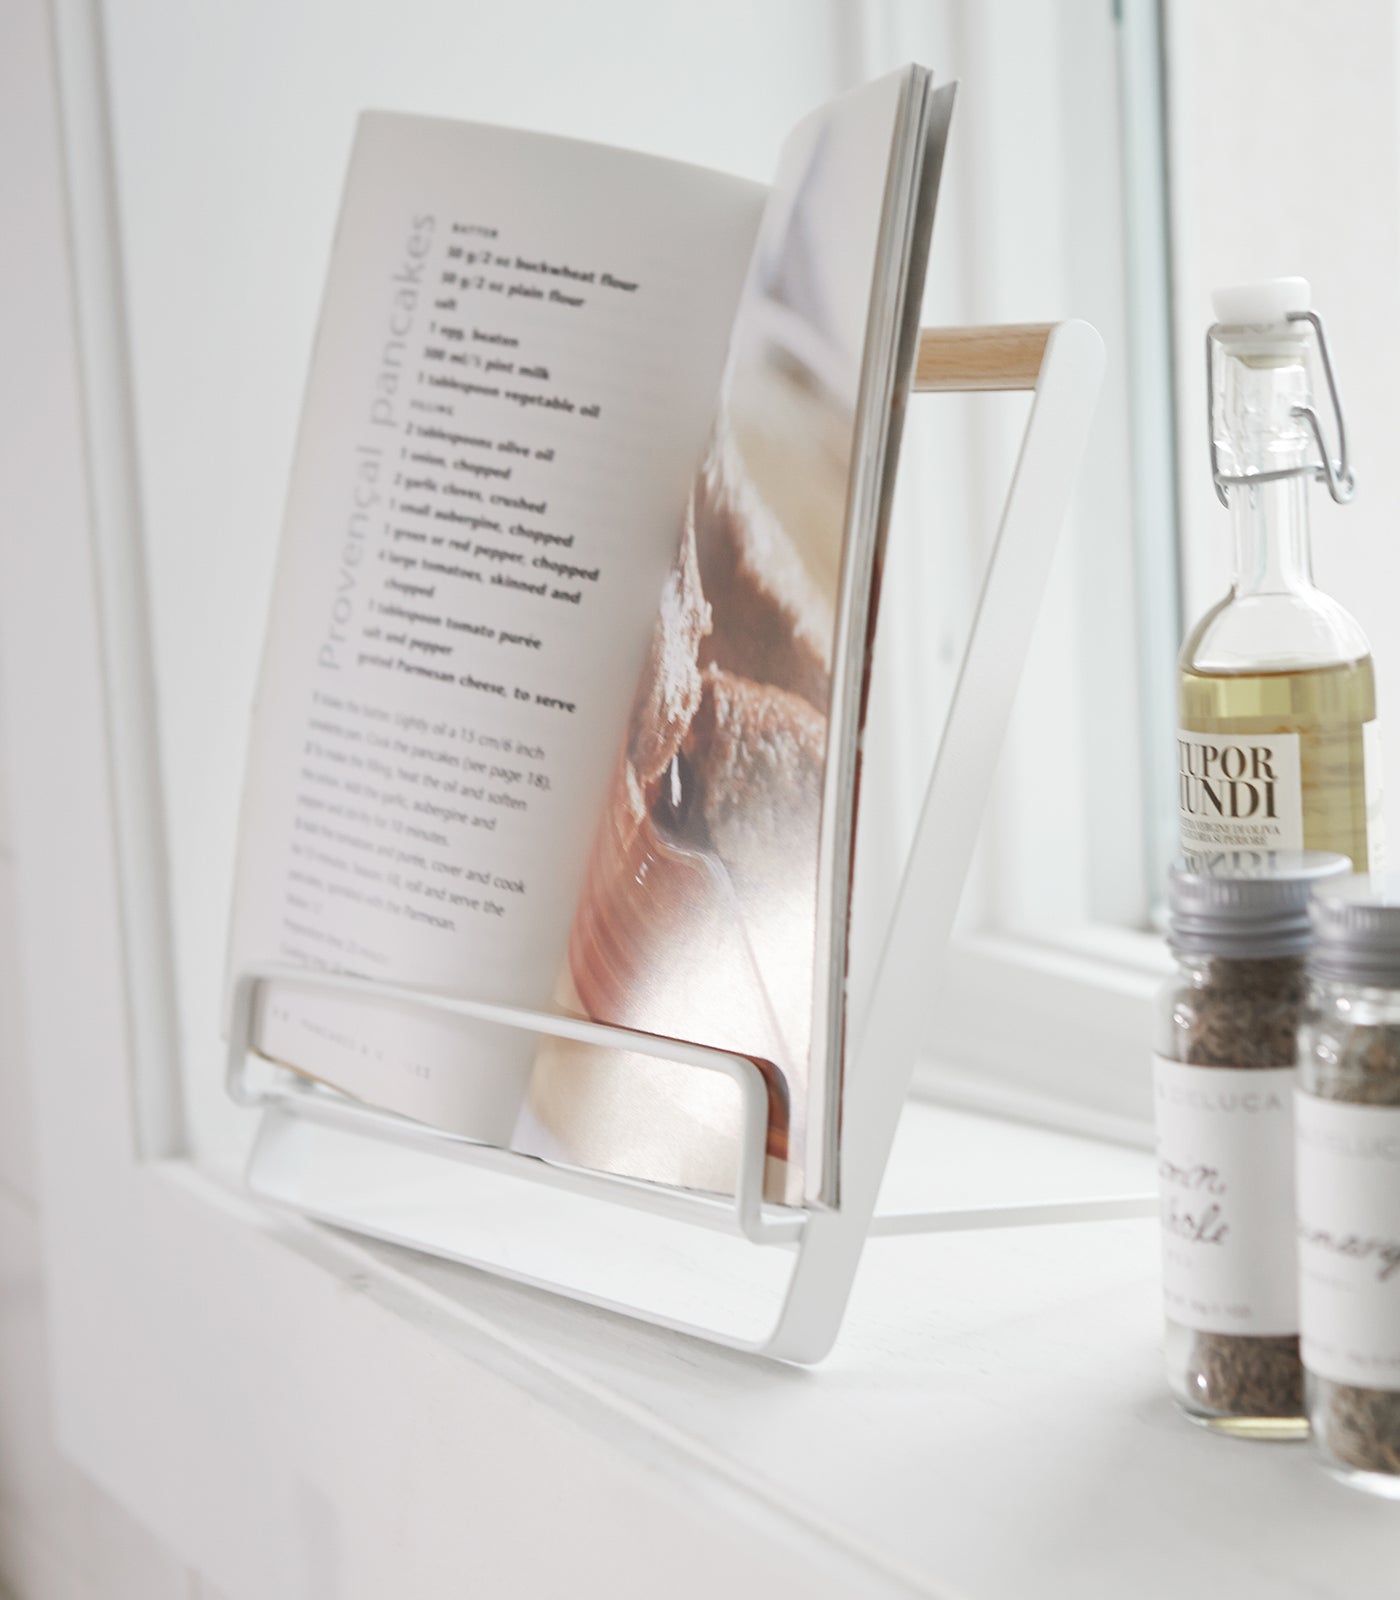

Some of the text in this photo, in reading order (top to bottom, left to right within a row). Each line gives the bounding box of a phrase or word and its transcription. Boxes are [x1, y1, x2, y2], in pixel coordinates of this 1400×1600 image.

[515, 256, 596, 282] buckwheat
[601, 273, 640, 292] flour
[507, 284, 544, 299] plain
[550, 289, 586, 307] flour
[370, 213, 436, 428] pancakes
[472, 328, 519, 347] beaten
[485, 358, 513, 372] pint
[518, 365, 551, 380] milk
[428, 375, 500, 396] tablespoon
[504, 391, 575, 412] vegetable
[579, 404, 601, 419] oil
[416, 426, 493, 449] tablespoons
[497, 440, 530, 456] olive
[534, 448, 555, 462] oil
[453, 459, 512, 480] chopped
[405, 478, 437, 492] garlic
[490, 494, 548, 514] crushed
[400, 503, 431, 516] small
[435, 511, 501, 534] aubergine,
[509, 524, 575, 548] chopped
[448, 540, 471, 551] red
[532, 556, 600, 582] chopped
[384, 577, 435, 598] chopped
[388, 553, 417, 569] large
[421, 559, 483, 583] tomatoes,
[490, 573, 548, 597] skinned
[551, 588, 582, 605] and
[377, 602, 442, 623] tablespoon
[446, 617, 496, 638] tomato
[499, 631, 543, 650] purée
[409, 638, 454, 654] pepper
[396, 658, 455, 682] Parmesan
[459, 674, 508, 698] cheese,
[514, 687, 531, 702] to
[535, 694, 577, 713] serve
[461, 727, 475, 743] 15
[515, 742, 545, 759] inch
[489, 766, 523, 784] page
[460, 785, 484, 801] and
[488, 792, 528, 811] soften
[413, 800, 469, 823] aubergine
[470, 815, 497, 832] and
[431, 860, 462, 876] cover
[465, 868, 491, 885] and
[493, 875, 526, 894] cook
[424, 886, 446, 901] and
[449, 893, 480, 910] serve
[482, 900, 505, 917] the
